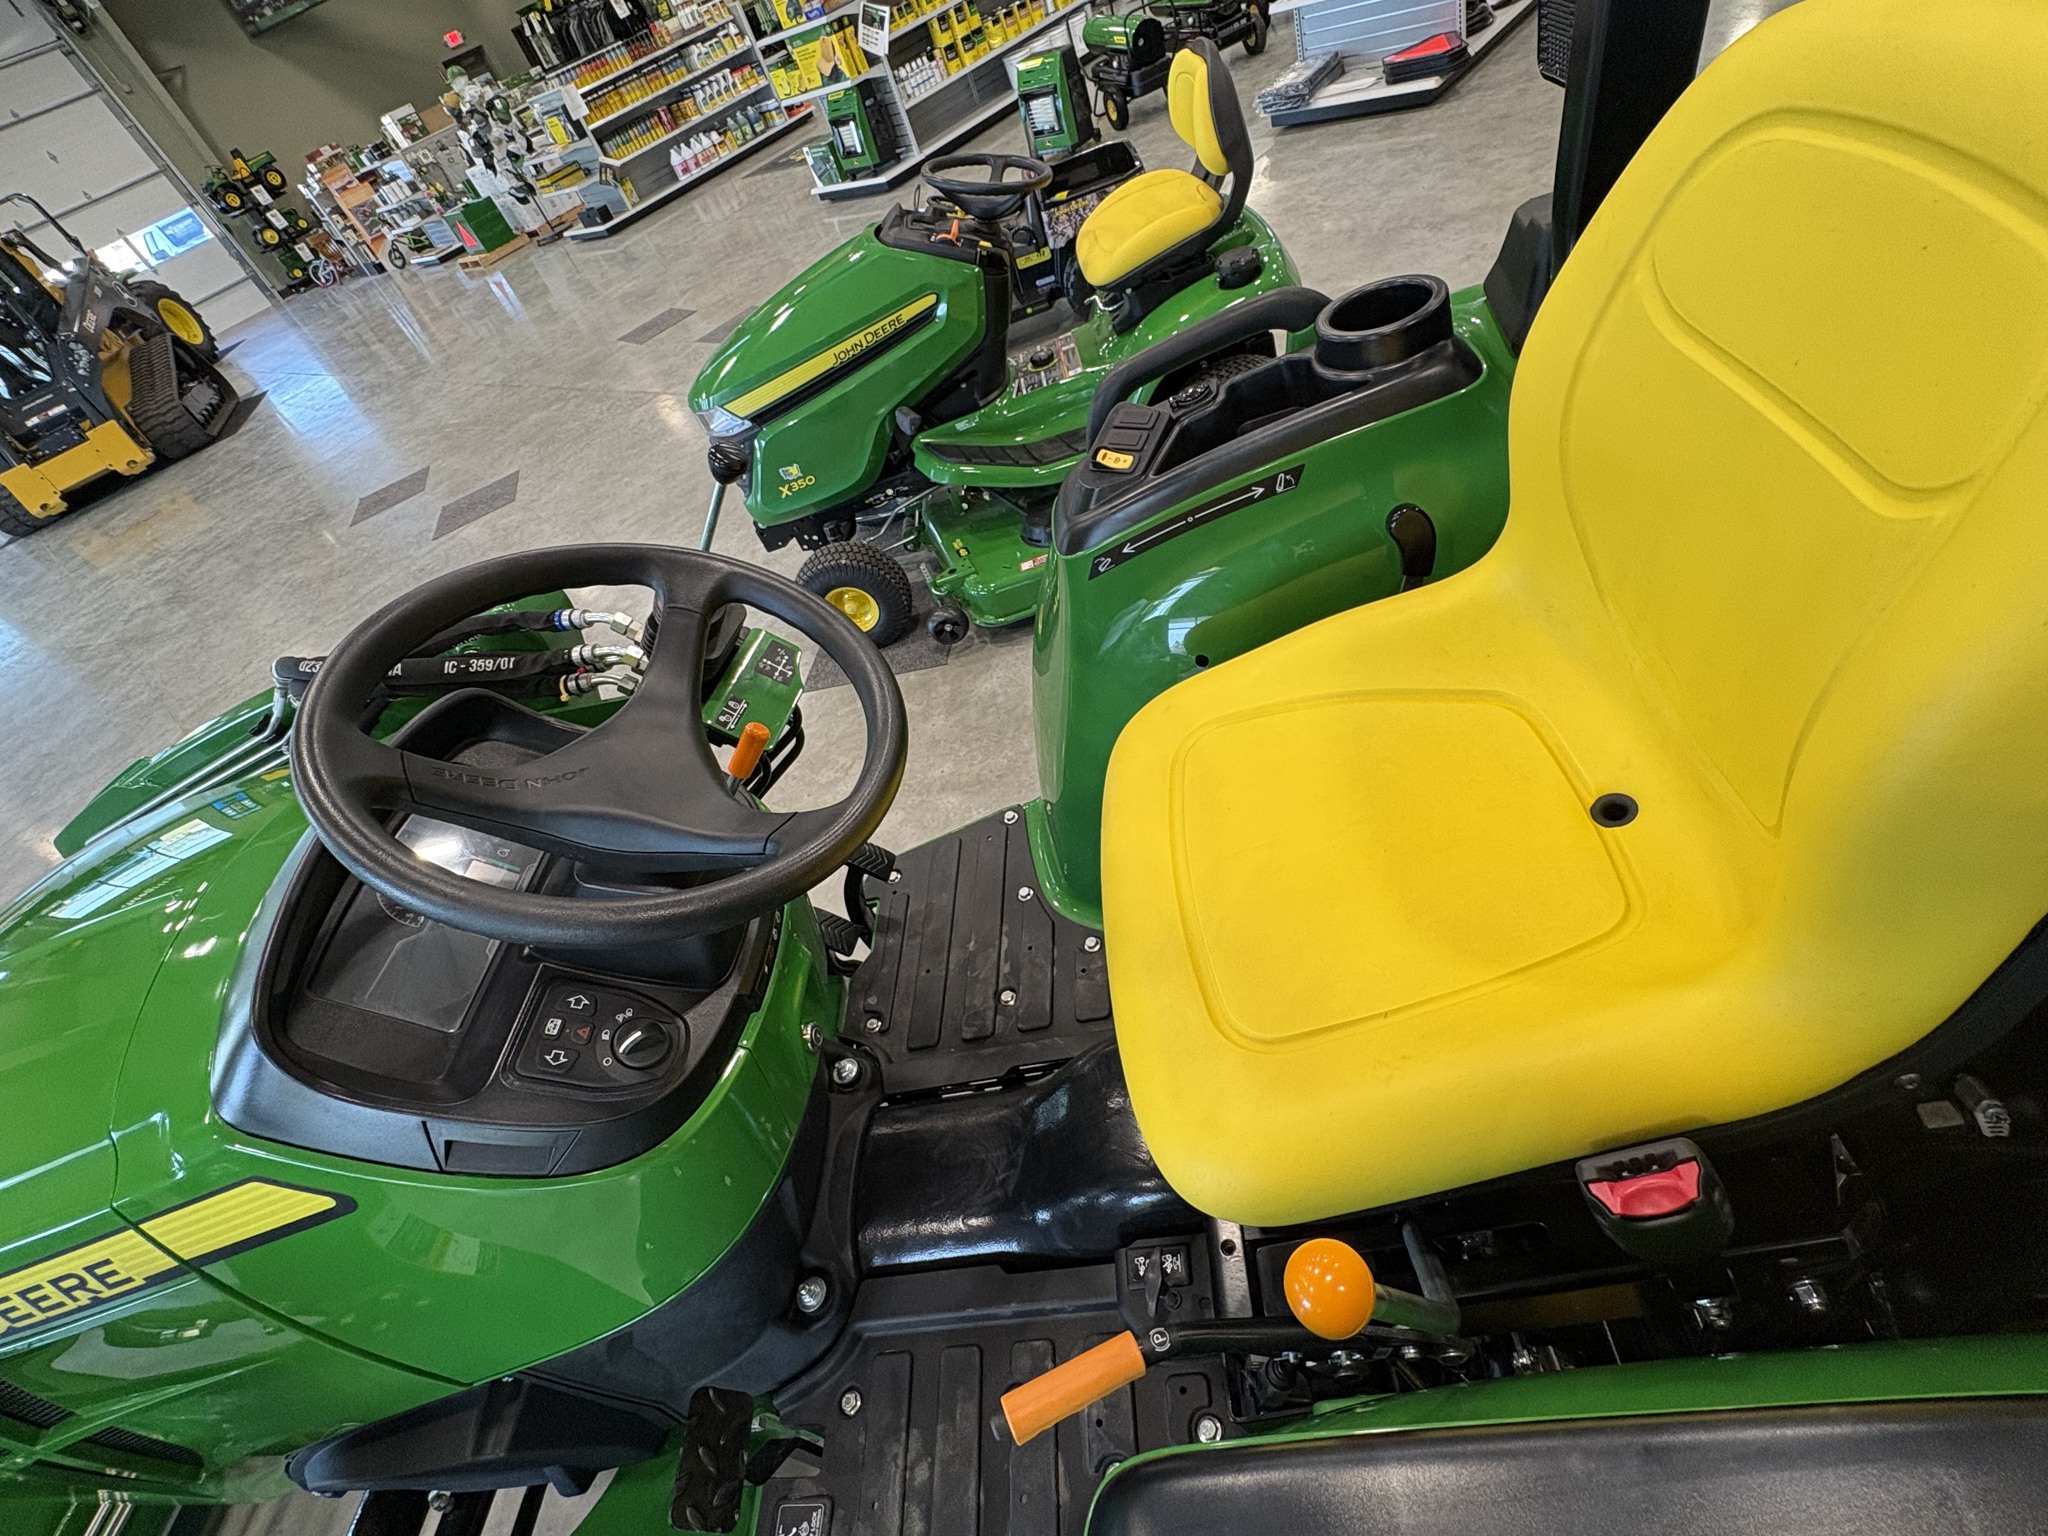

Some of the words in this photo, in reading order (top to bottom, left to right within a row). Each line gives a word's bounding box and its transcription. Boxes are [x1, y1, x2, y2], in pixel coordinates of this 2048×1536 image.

[832, 339, 864, 366] JOHN
[864, 313, 905, 345] DEERE
[778, 475, 816, 499] X350
[431, 766, 520, 790] DEERE
[524, 766, 591, 789] JOHN
